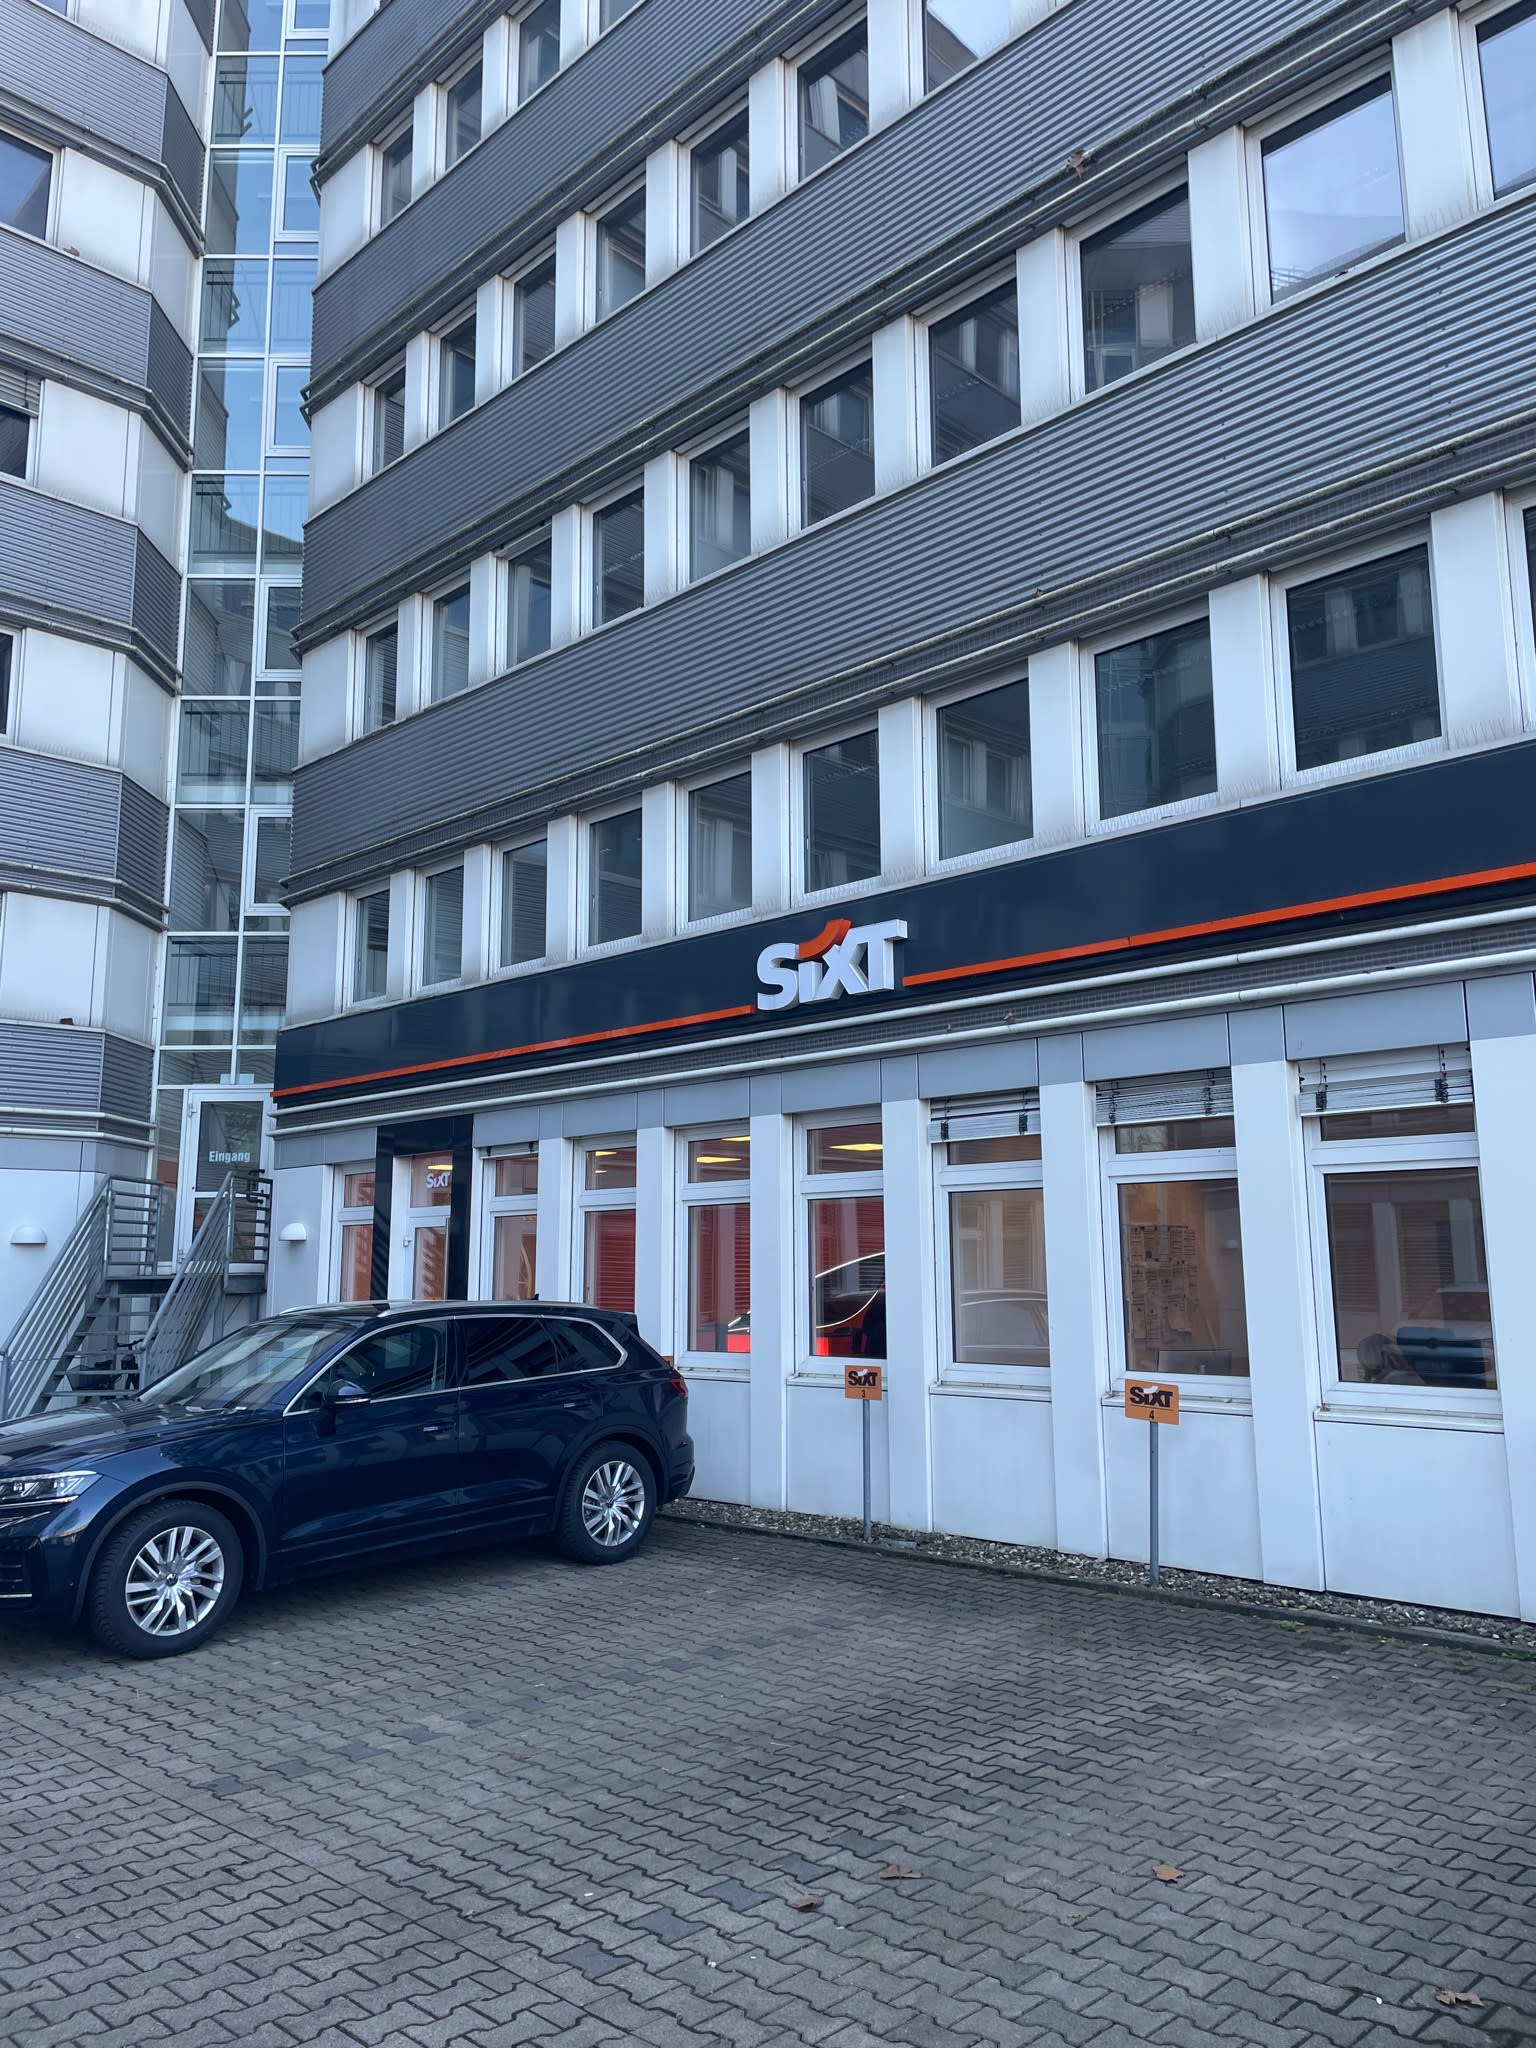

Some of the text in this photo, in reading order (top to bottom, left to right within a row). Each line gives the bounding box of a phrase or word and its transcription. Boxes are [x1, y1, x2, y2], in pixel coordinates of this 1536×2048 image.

[208, 1150, 250, 1163] Eingang
[861, 1389, 866, 1398] 3
[1149, 1410, 1155, 1420] 4
